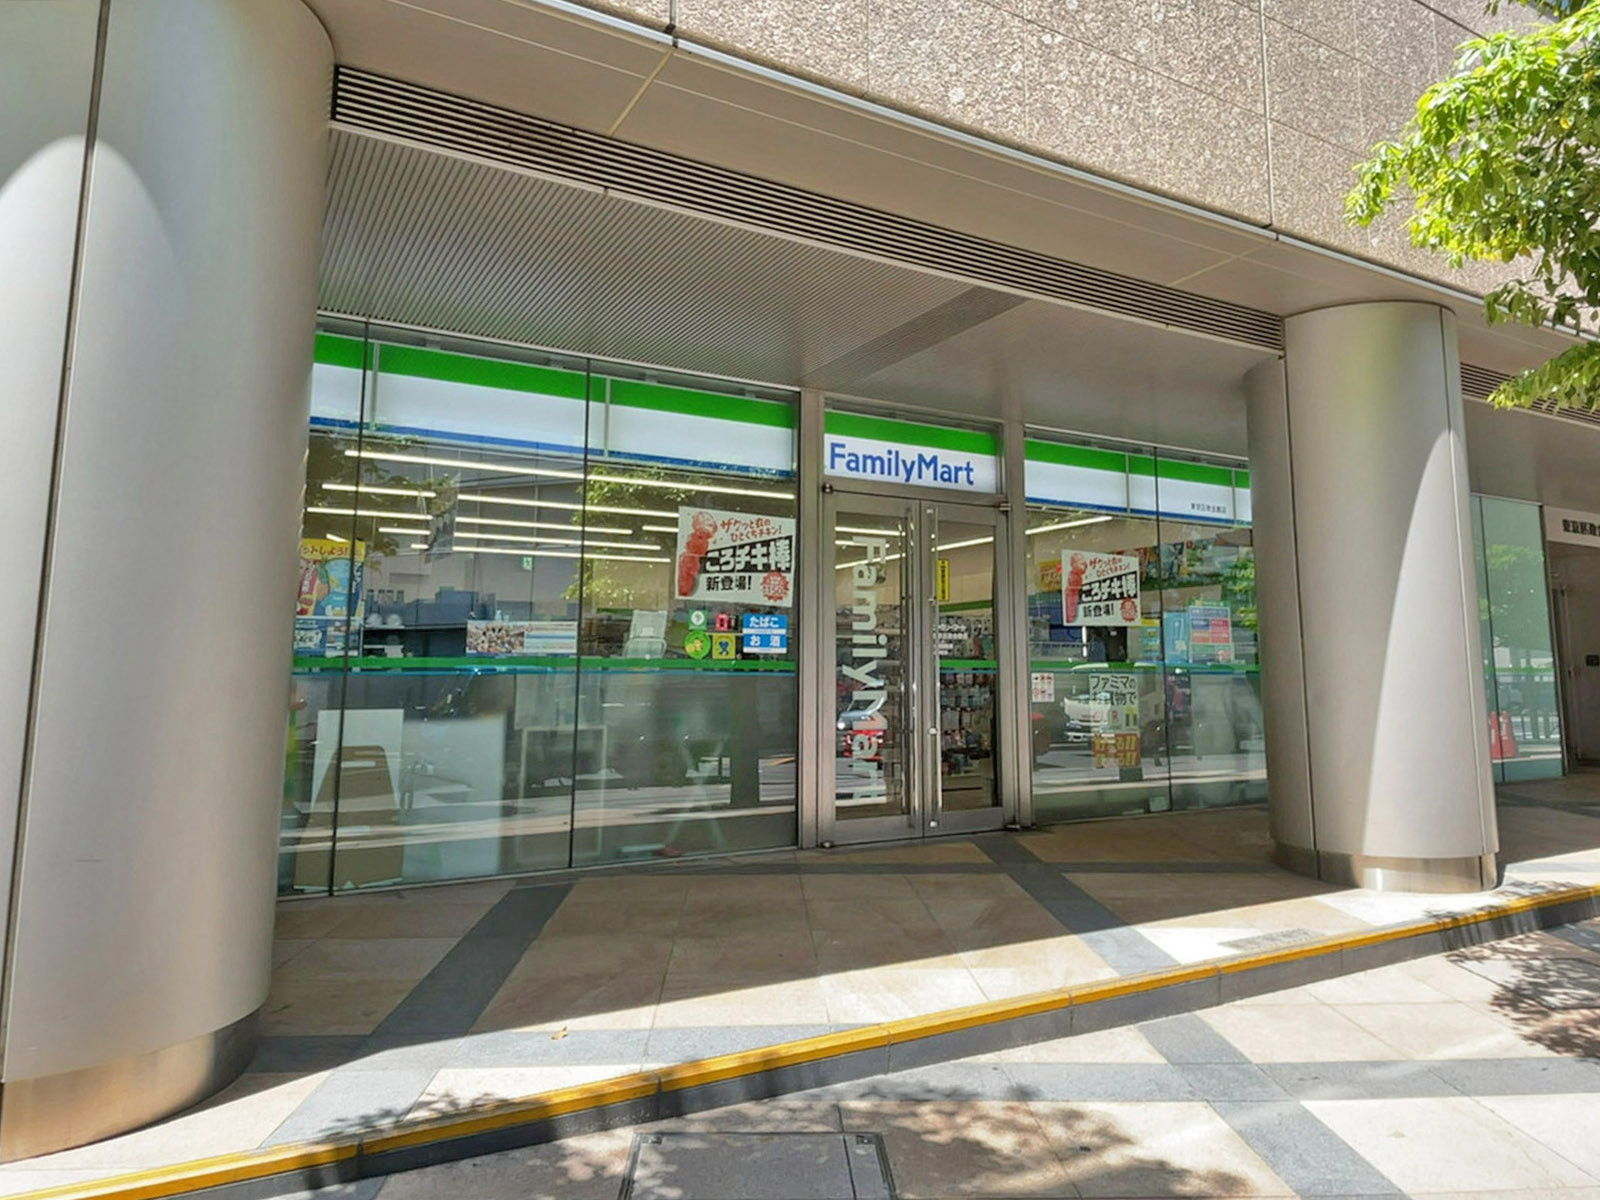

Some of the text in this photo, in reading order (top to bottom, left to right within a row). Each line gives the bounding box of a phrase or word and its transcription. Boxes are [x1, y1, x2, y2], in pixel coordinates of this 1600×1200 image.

[829, 442, 975, 486] FamilyMart
[705, 538, 791, 572] ころチキ棒
[705, 575, 752, 592] 新登場!
[1081, 573, 1137, 601] ころチキ棒
[749, 615, 780, 628] たばこ
[1089, 674, 1137, 690] ファミマの
